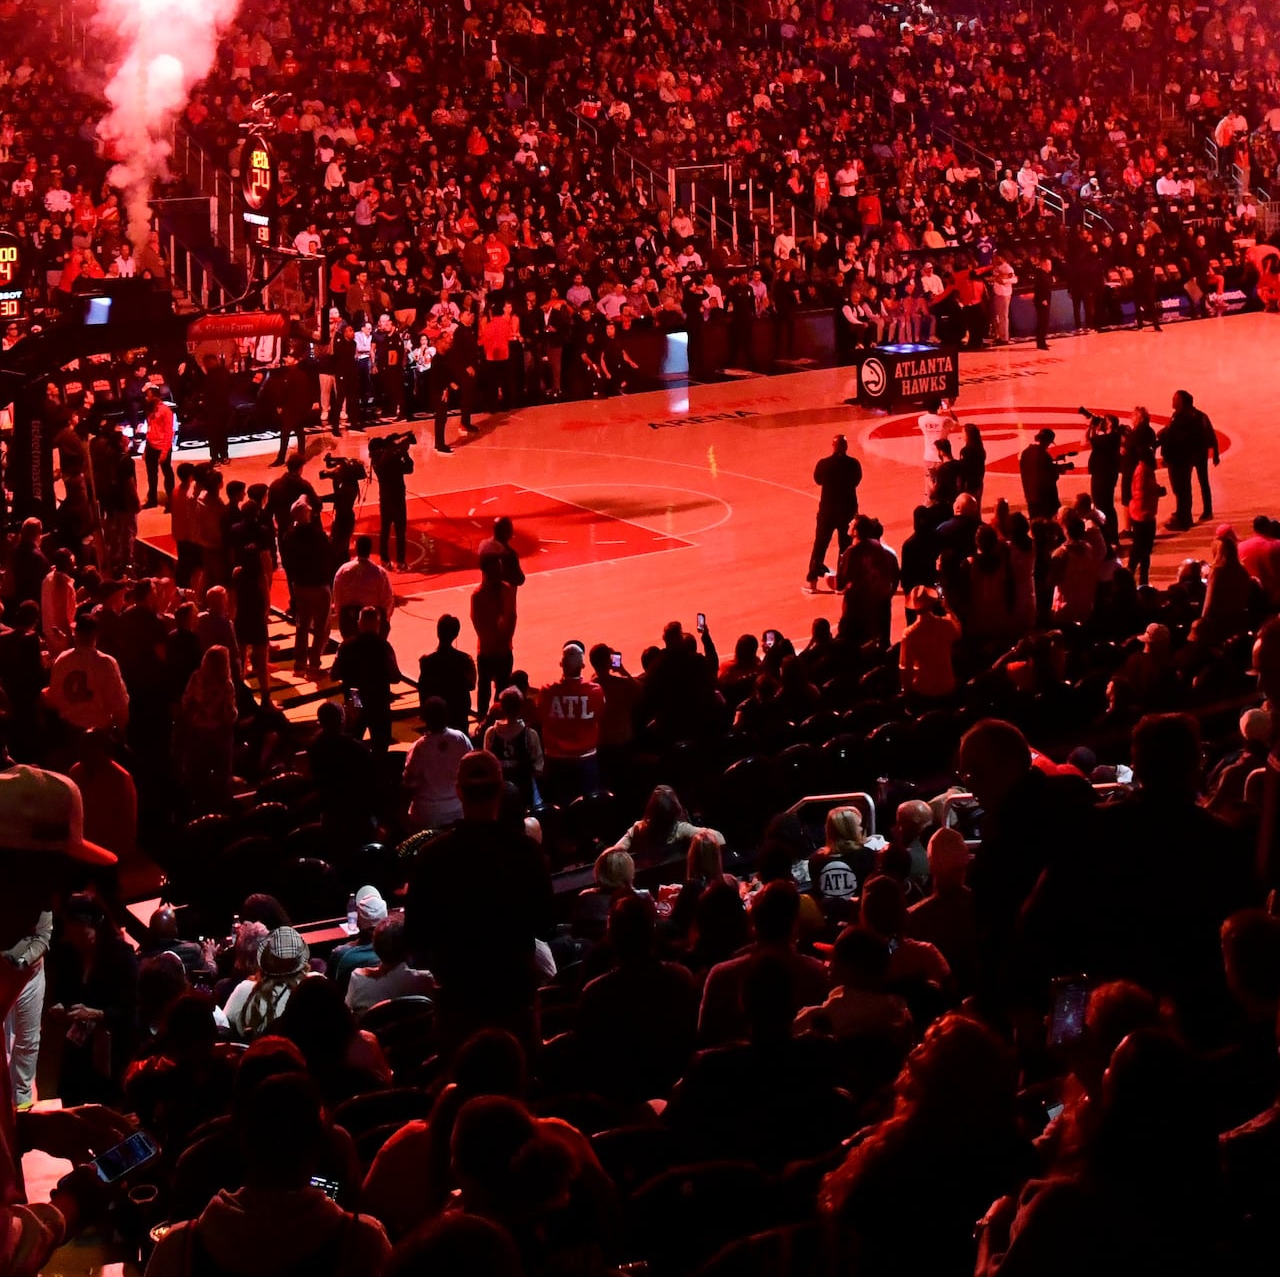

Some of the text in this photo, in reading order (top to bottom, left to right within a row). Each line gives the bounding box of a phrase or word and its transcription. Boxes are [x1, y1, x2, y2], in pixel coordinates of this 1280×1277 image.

[894, 356, 954, 379] ATLANTA
[901, 375, 947, 396] HAWKS
[648, 410, 759, 430] ARENA
[549, 695, 595, 720] ATL
[824, 873, 853, 891] ATL
